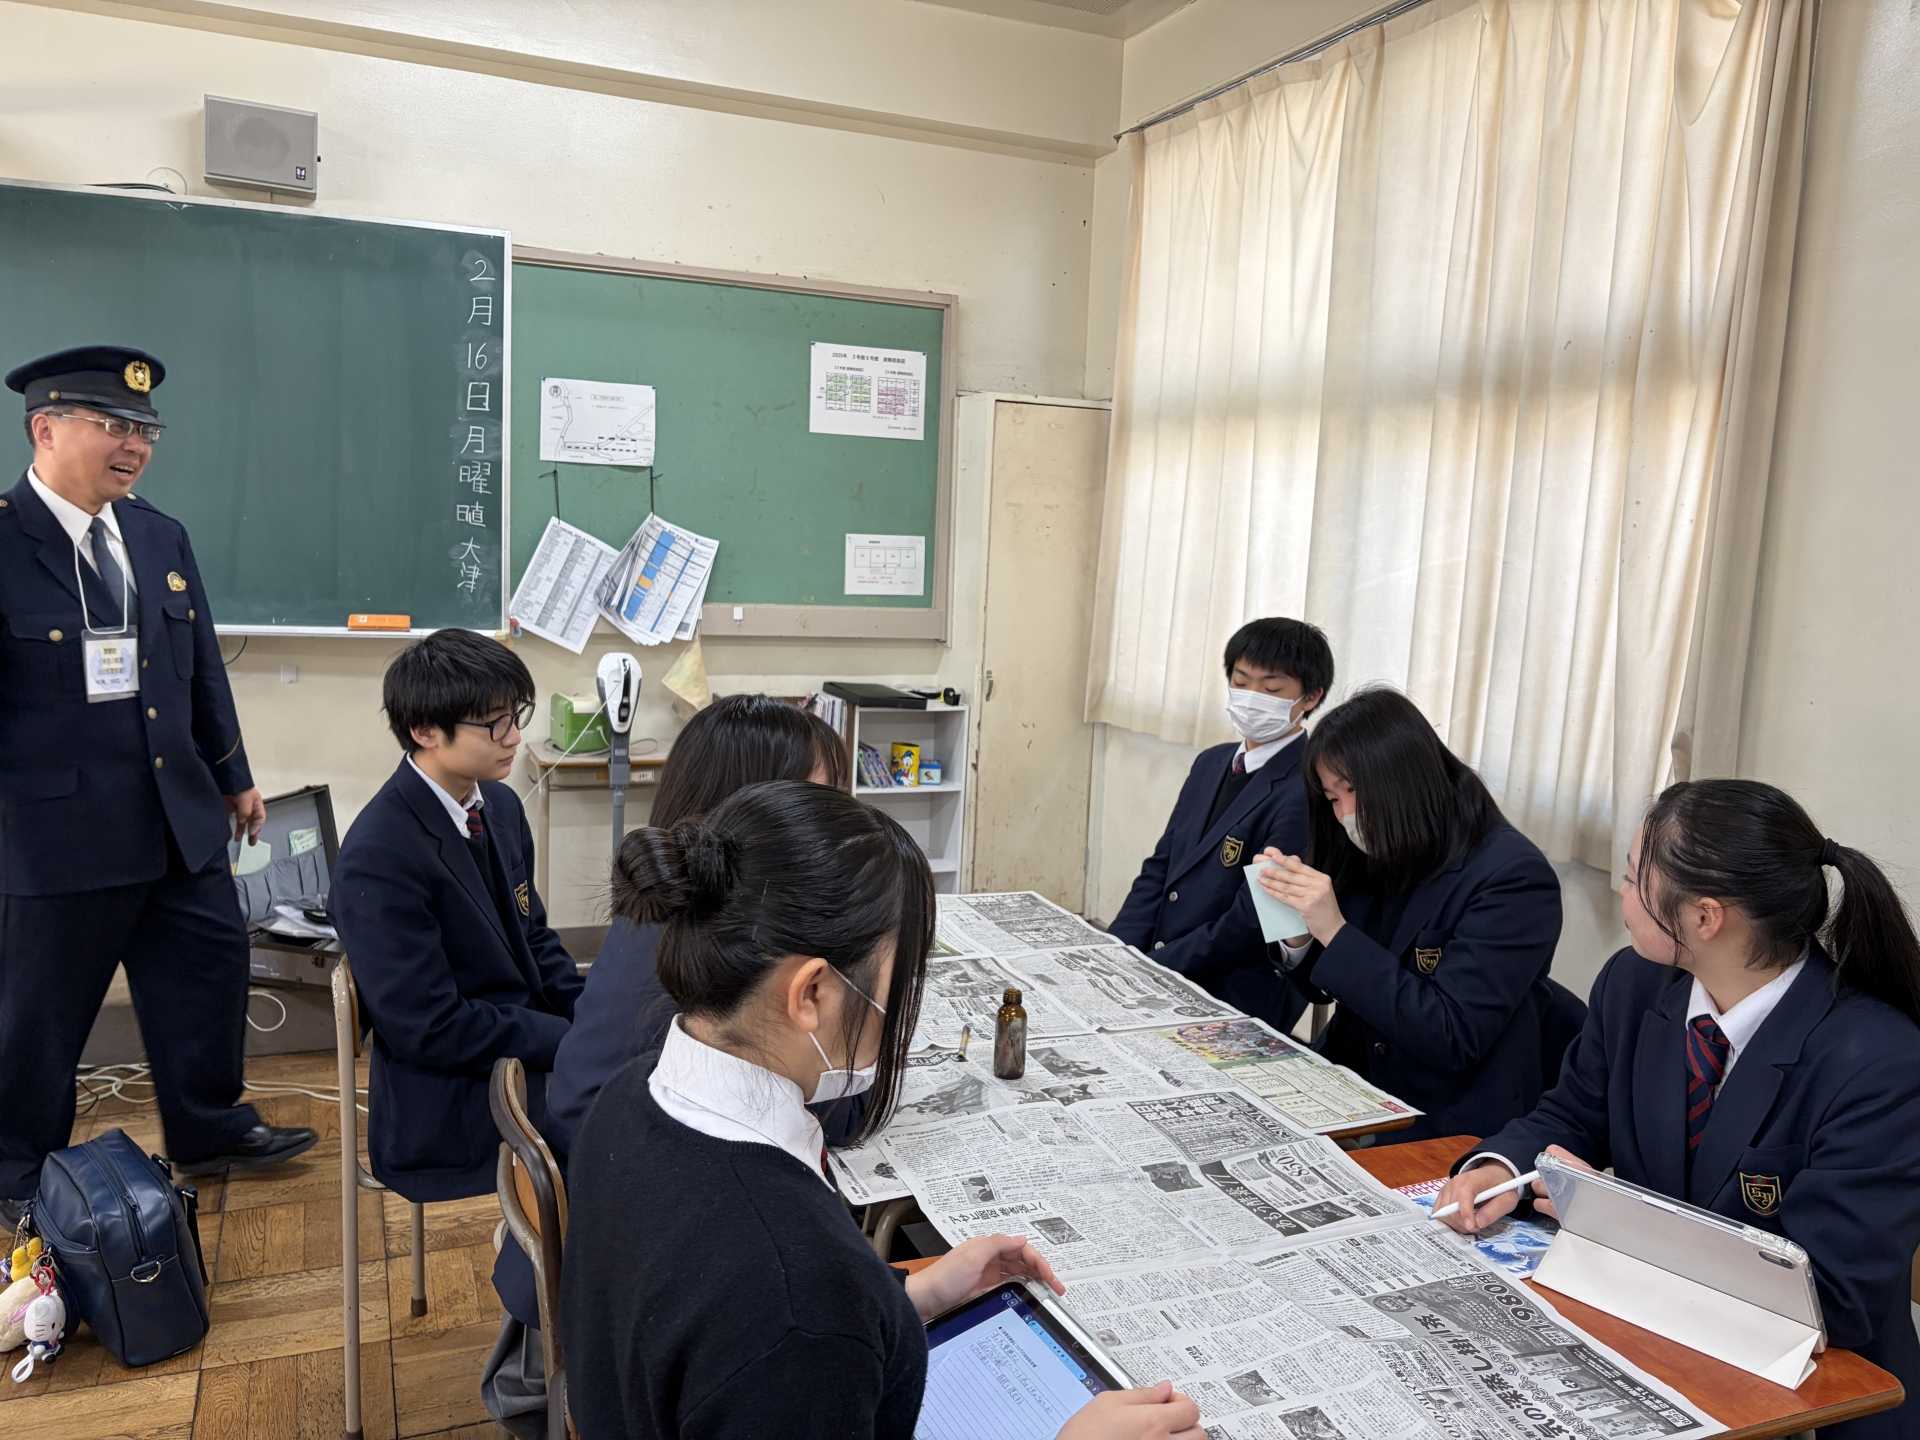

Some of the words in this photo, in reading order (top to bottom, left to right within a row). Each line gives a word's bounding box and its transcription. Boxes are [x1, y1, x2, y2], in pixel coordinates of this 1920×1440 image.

[1413, 1314, 1577, 1440] 気の深蒸し掛川茶
